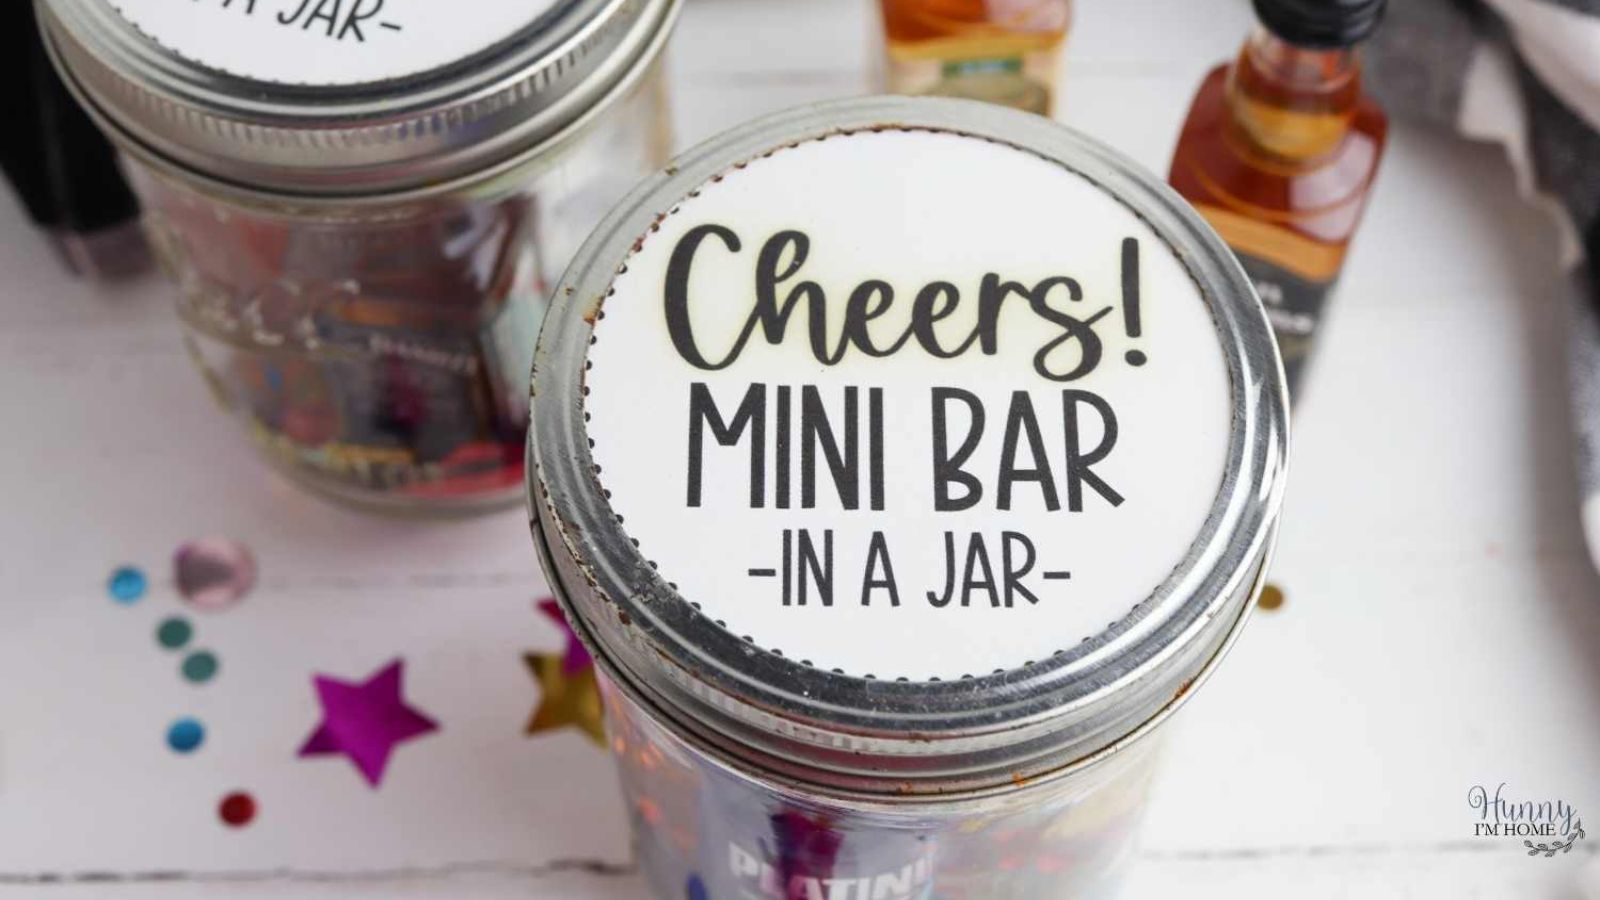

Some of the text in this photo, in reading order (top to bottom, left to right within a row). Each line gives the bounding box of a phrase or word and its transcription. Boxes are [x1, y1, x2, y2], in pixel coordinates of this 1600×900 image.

[664, 223, 1147, 383] Cheers!
[687, 382, 1125, 513] MINI BAR
[748, 528, 1071, 608] -IN A JAR-
